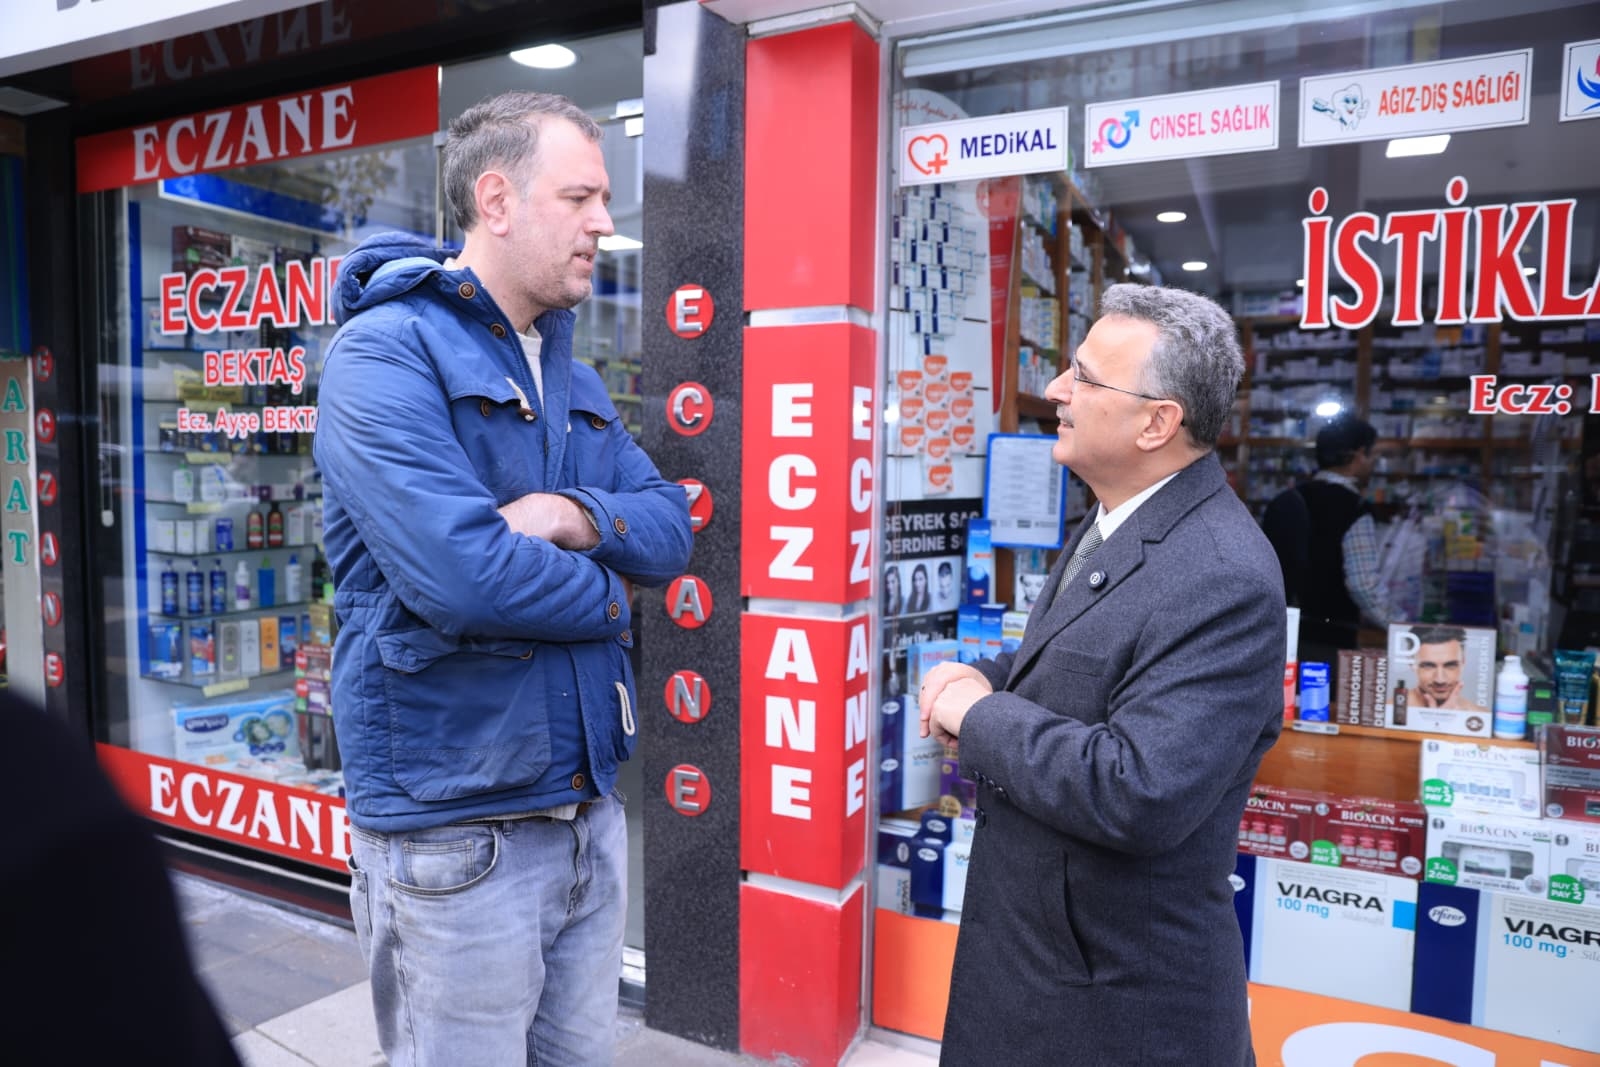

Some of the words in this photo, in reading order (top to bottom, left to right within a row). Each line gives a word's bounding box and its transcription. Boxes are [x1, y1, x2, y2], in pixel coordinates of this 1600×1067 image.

[1452, 71, 1521, 109] SAĞLIĞI
[133, 86, 356, 181] ECZANE
[1210, 104, 1270, 135] SAĞLIK
[203, 346, 306, 394] BEKTAŞ
[177, 408, 213, 433] Ecz.
[215, 408, 260, 438] Ayşe
[1, 352, 31, 564] ARAT
[37, 348, 60, 682] ECZANE
[672, 289, 705, 812] ECZANE
[765, 383, 818, 820] ECZANE
[845, 386, 873, 818] ECZANE
[1350, 655, 1362, 724] DERMOSKIN
[1374, 657, 1387, 727] DERMOSKIN
[148, 763, 351, 861] ECZANE
[1341, 810, 1395, 825] BIOXCIN
[1460, 823, 1517, 839] BIOXCIN
[1277, 881, 1384, 912] VIAGRA
[1277, 897, 1302, 911] 100
[1306, 902, 1330, 919] mg
[1551, 889, 1571, 897] PAY
[1573, 891, 1582, 900] 2
[1503, 933, 1533, 949] 100
[1538, 941, 1567, 958] mg
